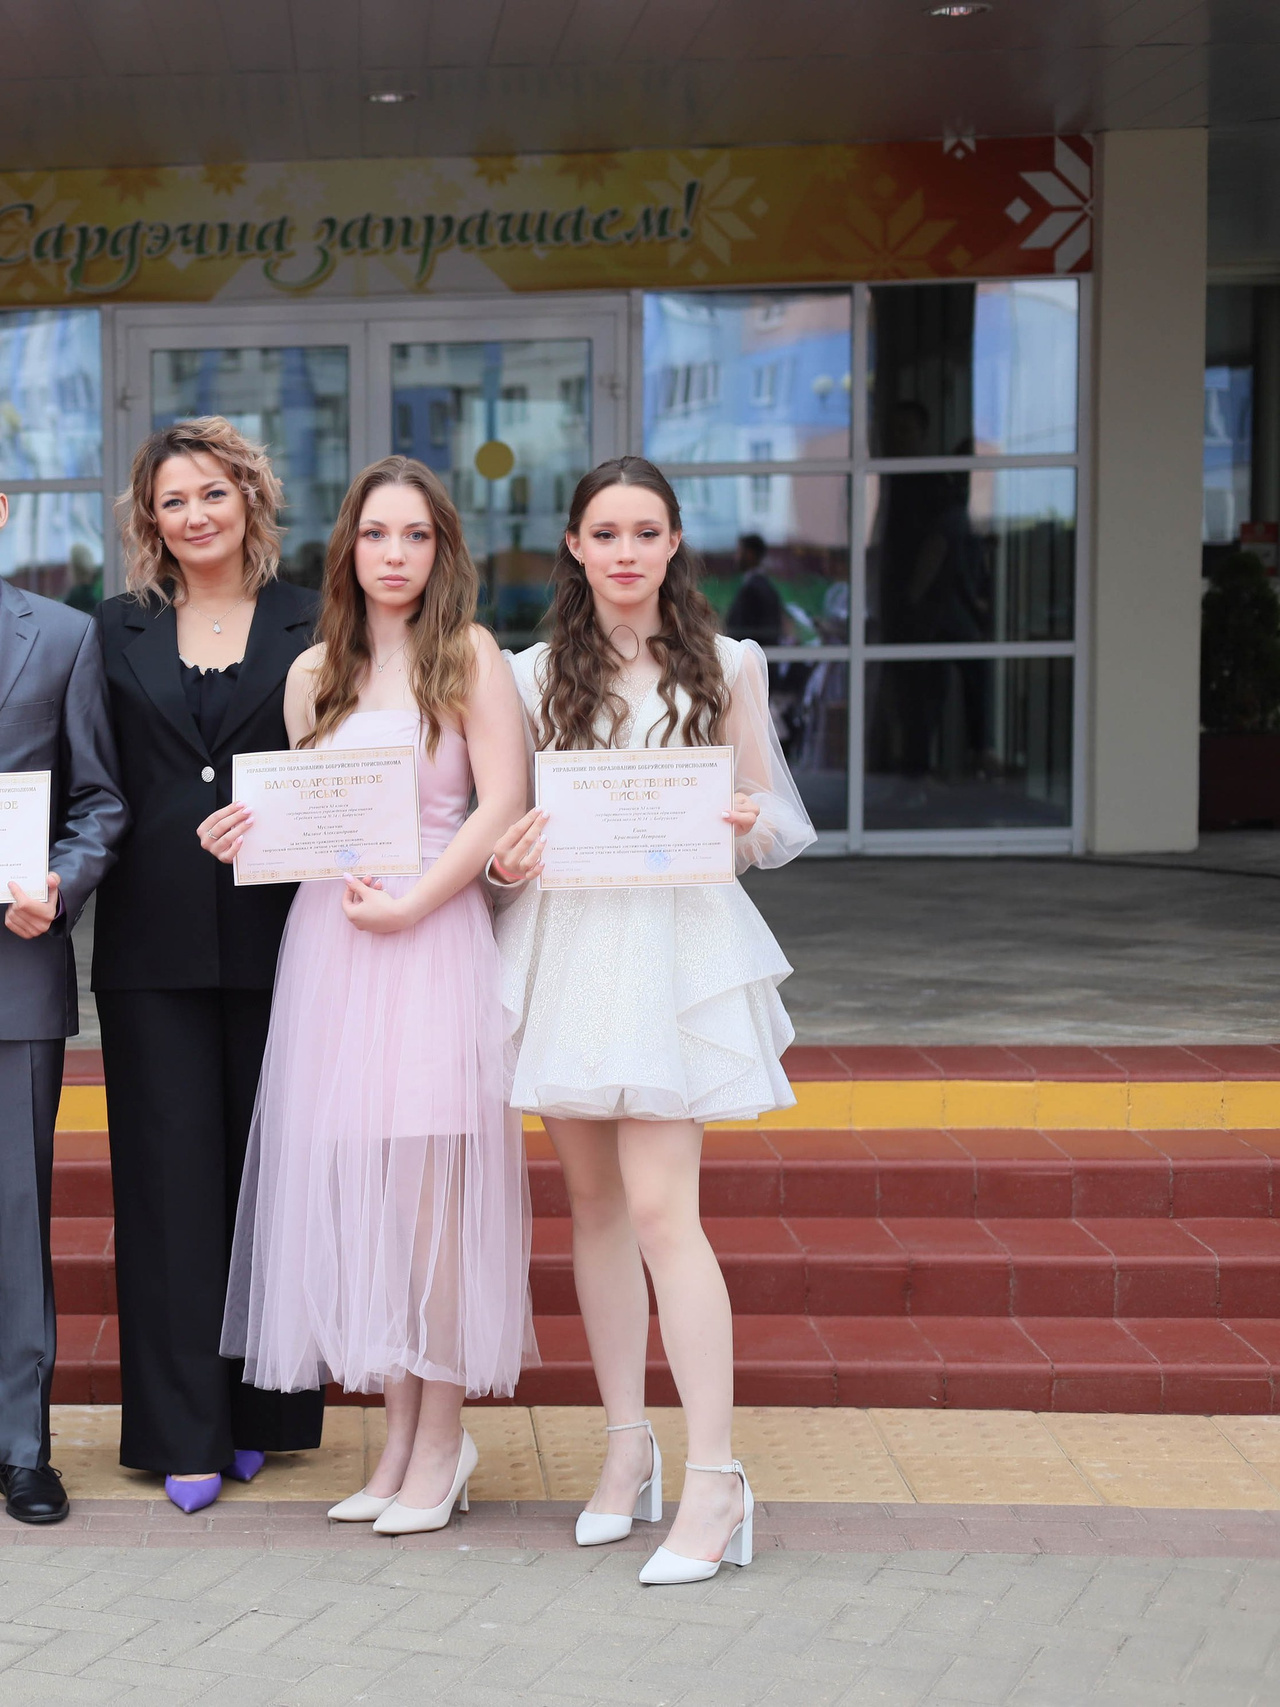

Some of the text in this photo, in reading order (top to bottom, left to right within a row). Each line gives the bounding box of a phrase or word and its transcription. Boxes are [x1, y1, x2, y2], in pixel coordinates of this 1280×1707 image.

[263, 180, 701, 290] запрашаем!
[264, 774, 382, 789] БЛАГОДАРСТВЕННОЕ
[572, 776, 697, 790] БЛАГОДАРСТВЕННОЕ
[299, 788, 348, 799] ПИСЬМО
[610, 790, 660, 801] ПИСЬМО
